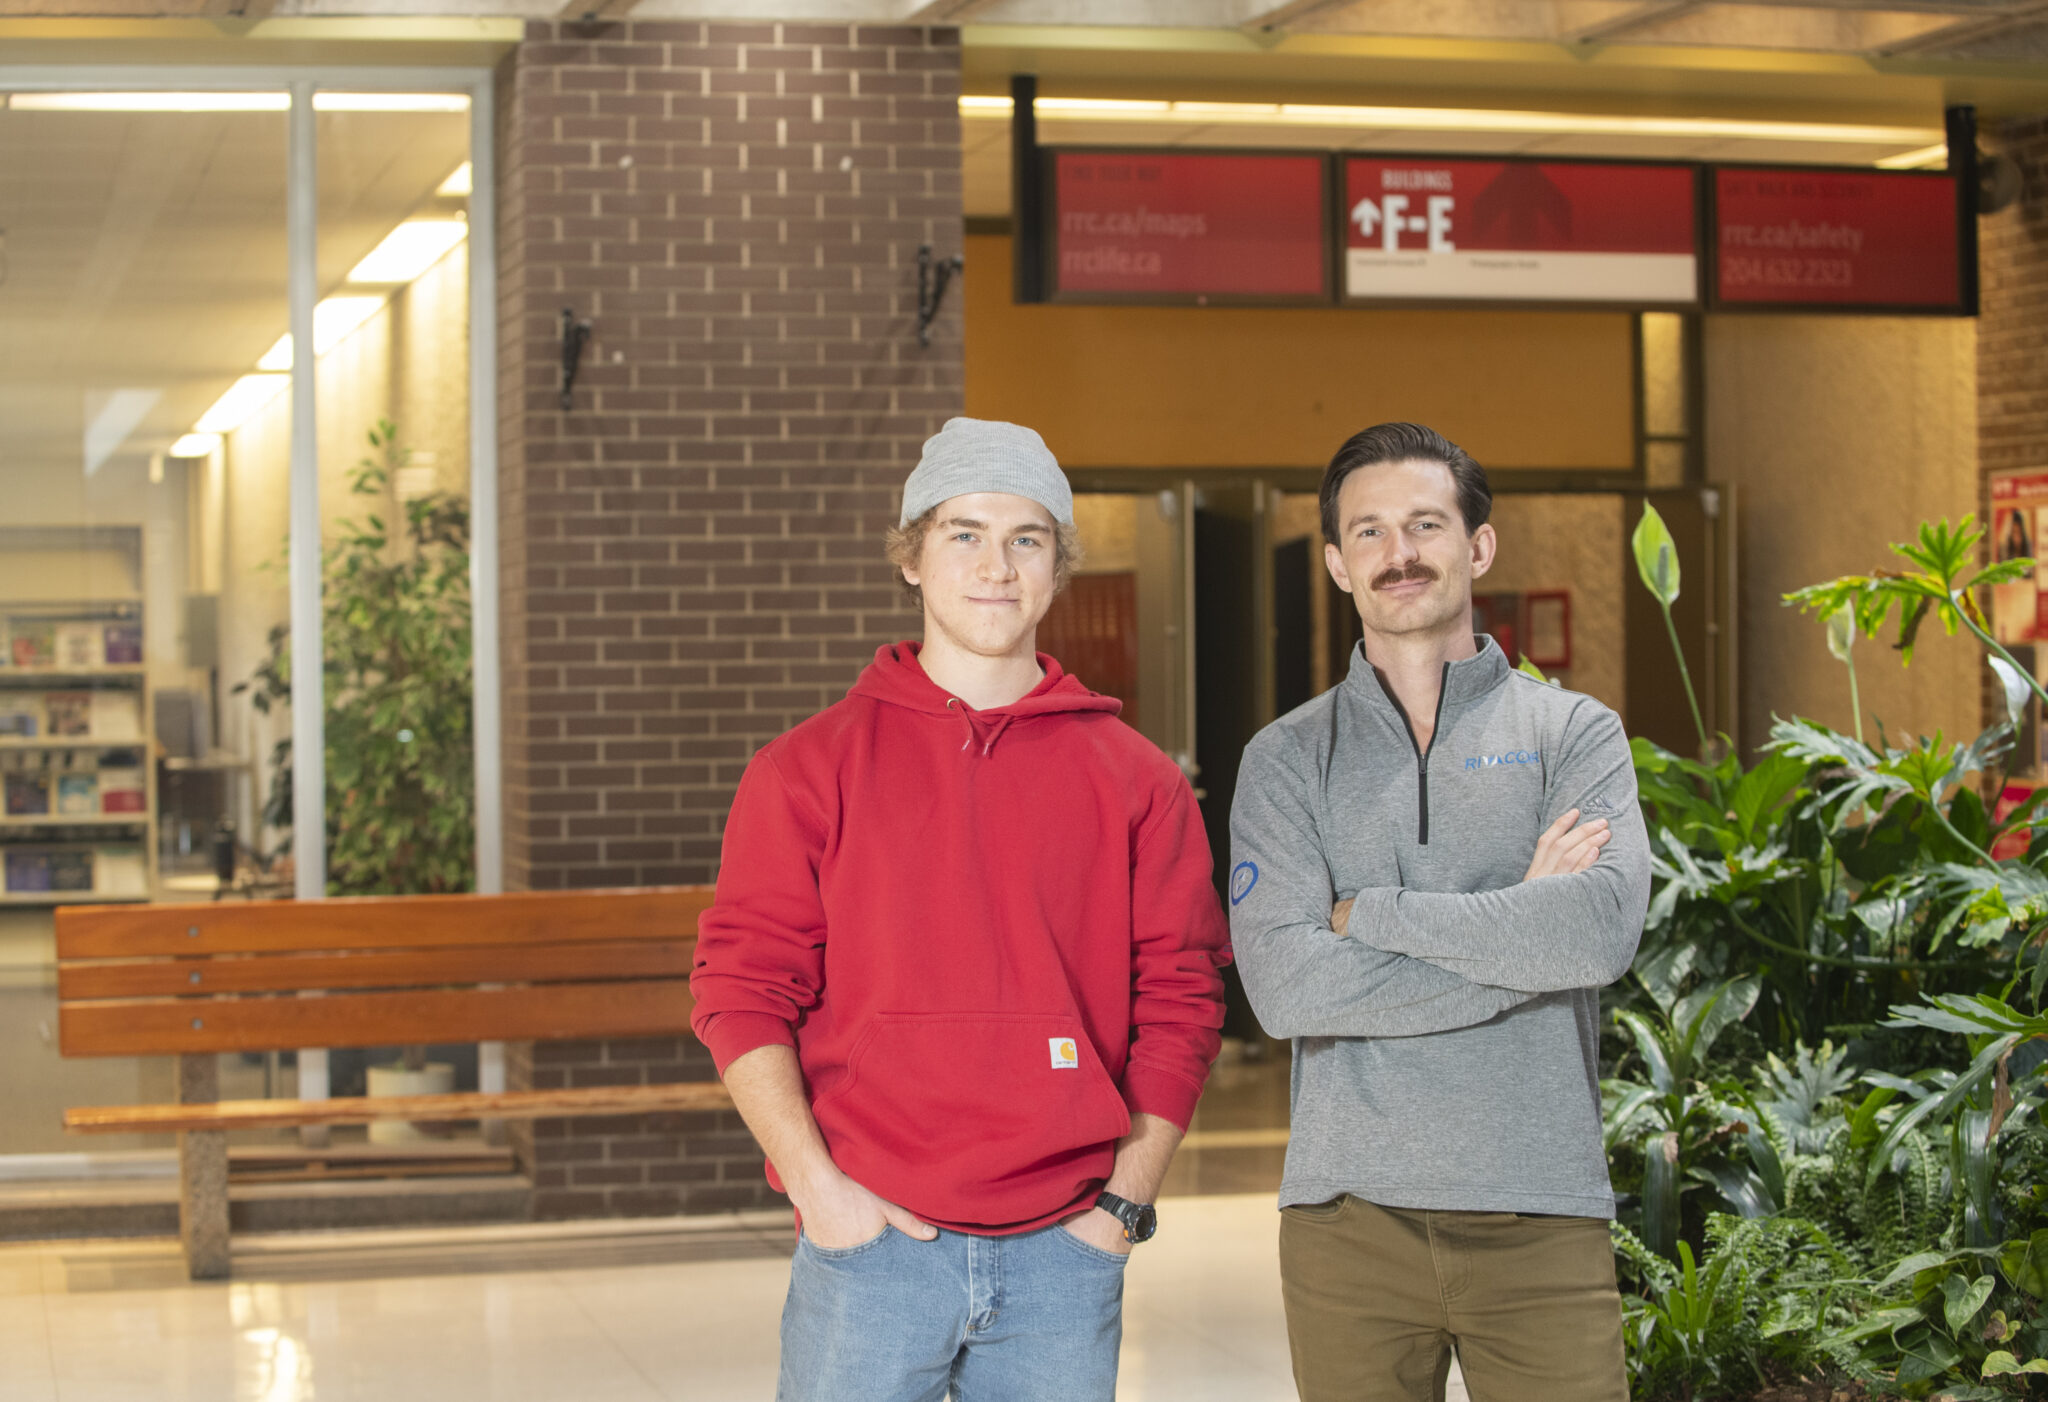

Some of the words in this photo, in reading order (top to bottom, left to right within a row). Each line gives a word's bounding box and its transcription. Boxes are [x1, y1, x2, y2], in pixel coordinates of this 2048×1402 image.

[1381, 168, 1453, 191] BUILDINGS
[1061, 204, 1206, 240] rrc.ca/maps
[1382, 195, 1456, 254] F-E
[1722, 219, 1863, 253] rrc.ca/safety
[1061, 246, 1162, 275] rrclife.ca
